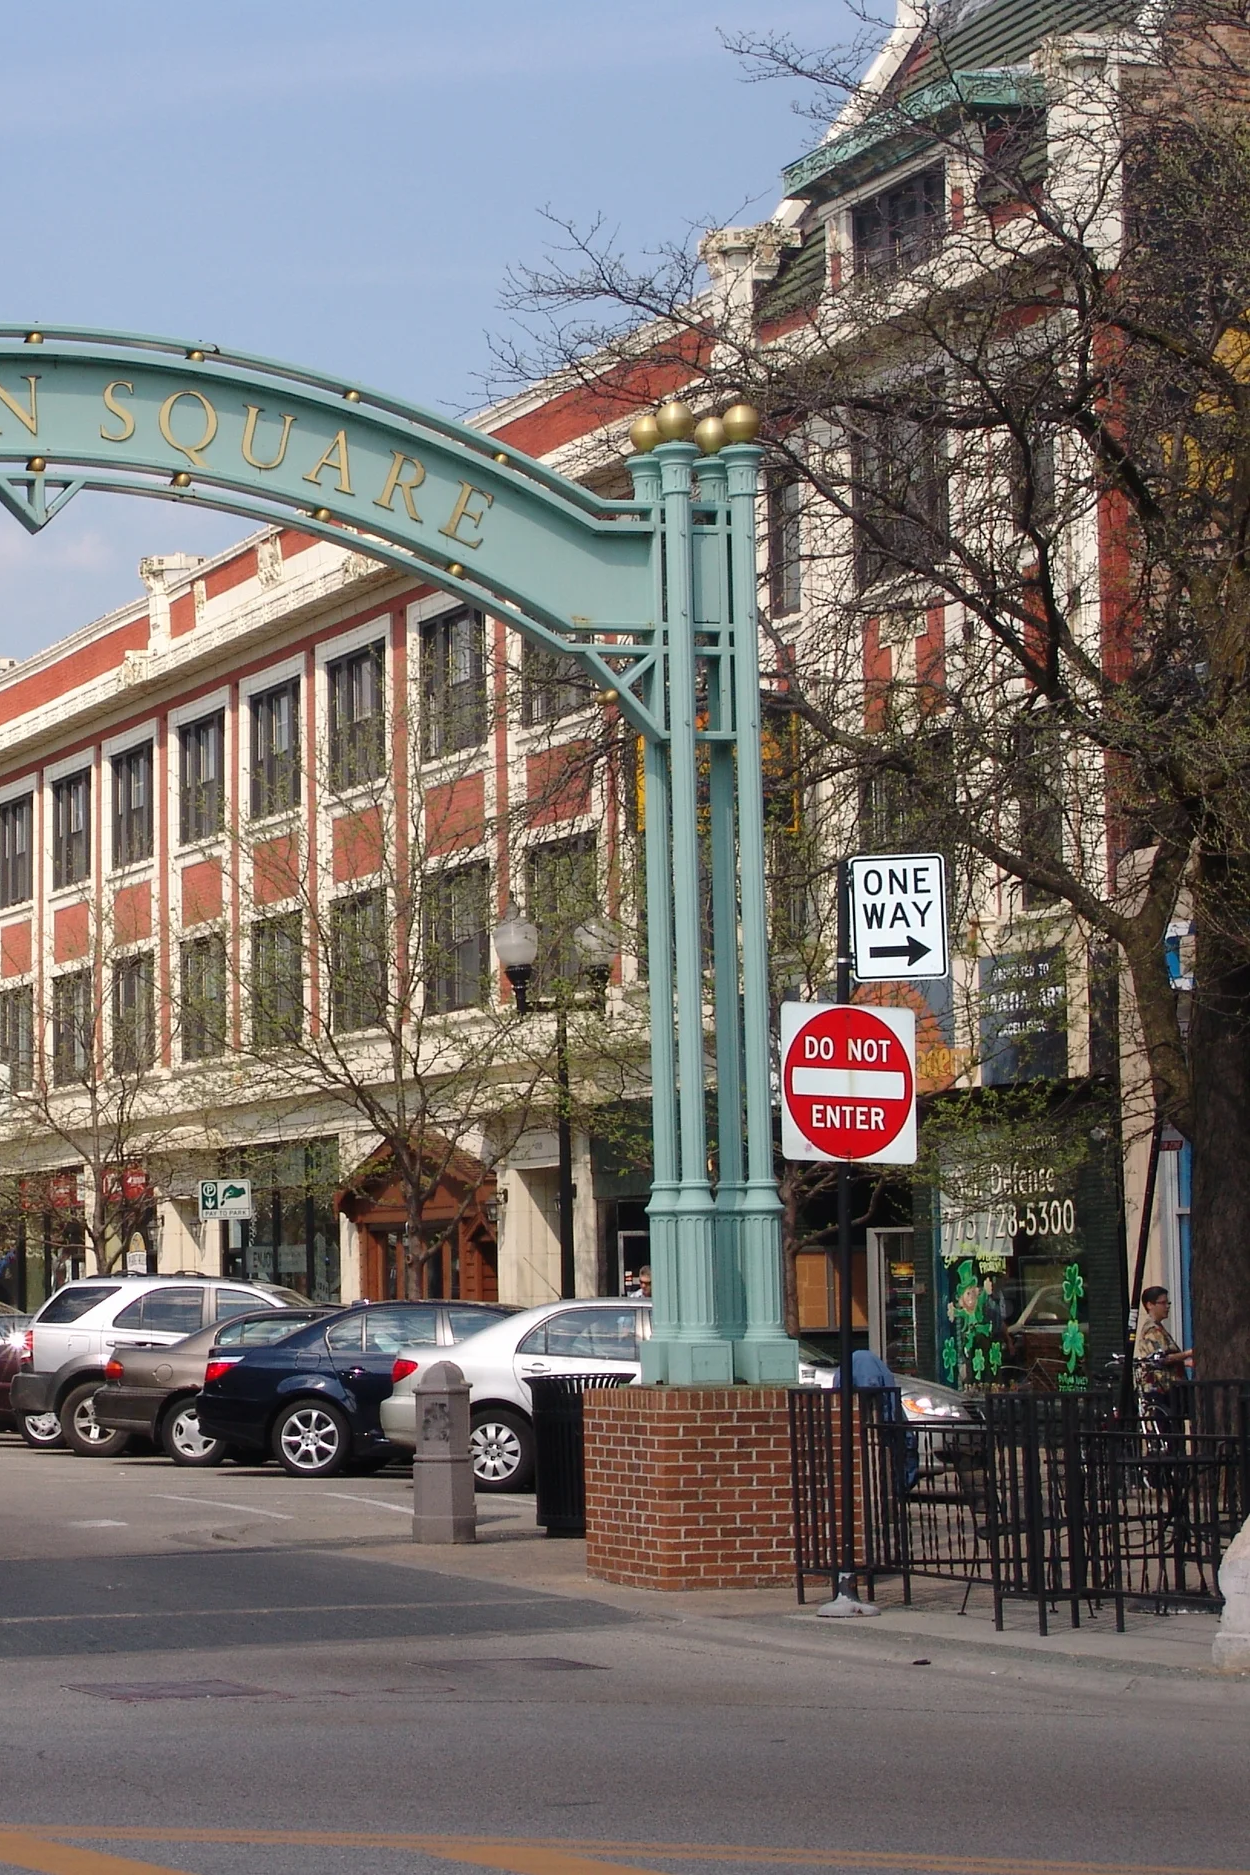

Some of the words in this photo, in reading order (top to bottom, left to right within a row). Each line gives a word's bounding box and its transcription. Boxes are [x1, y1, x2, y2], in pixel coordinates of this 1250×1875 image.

[100, 380, 495, 549] SQUARE
[864, 867, 931, 896] ONE
[862, 900, 933, 929] WAY
[804, 1035, 834, 1060] DO
[848, 1038, 891, 1063] NOT
[812, 1104, 885, 1130] ENTER
[984, 1199, 1075, 1240] 728-5300
